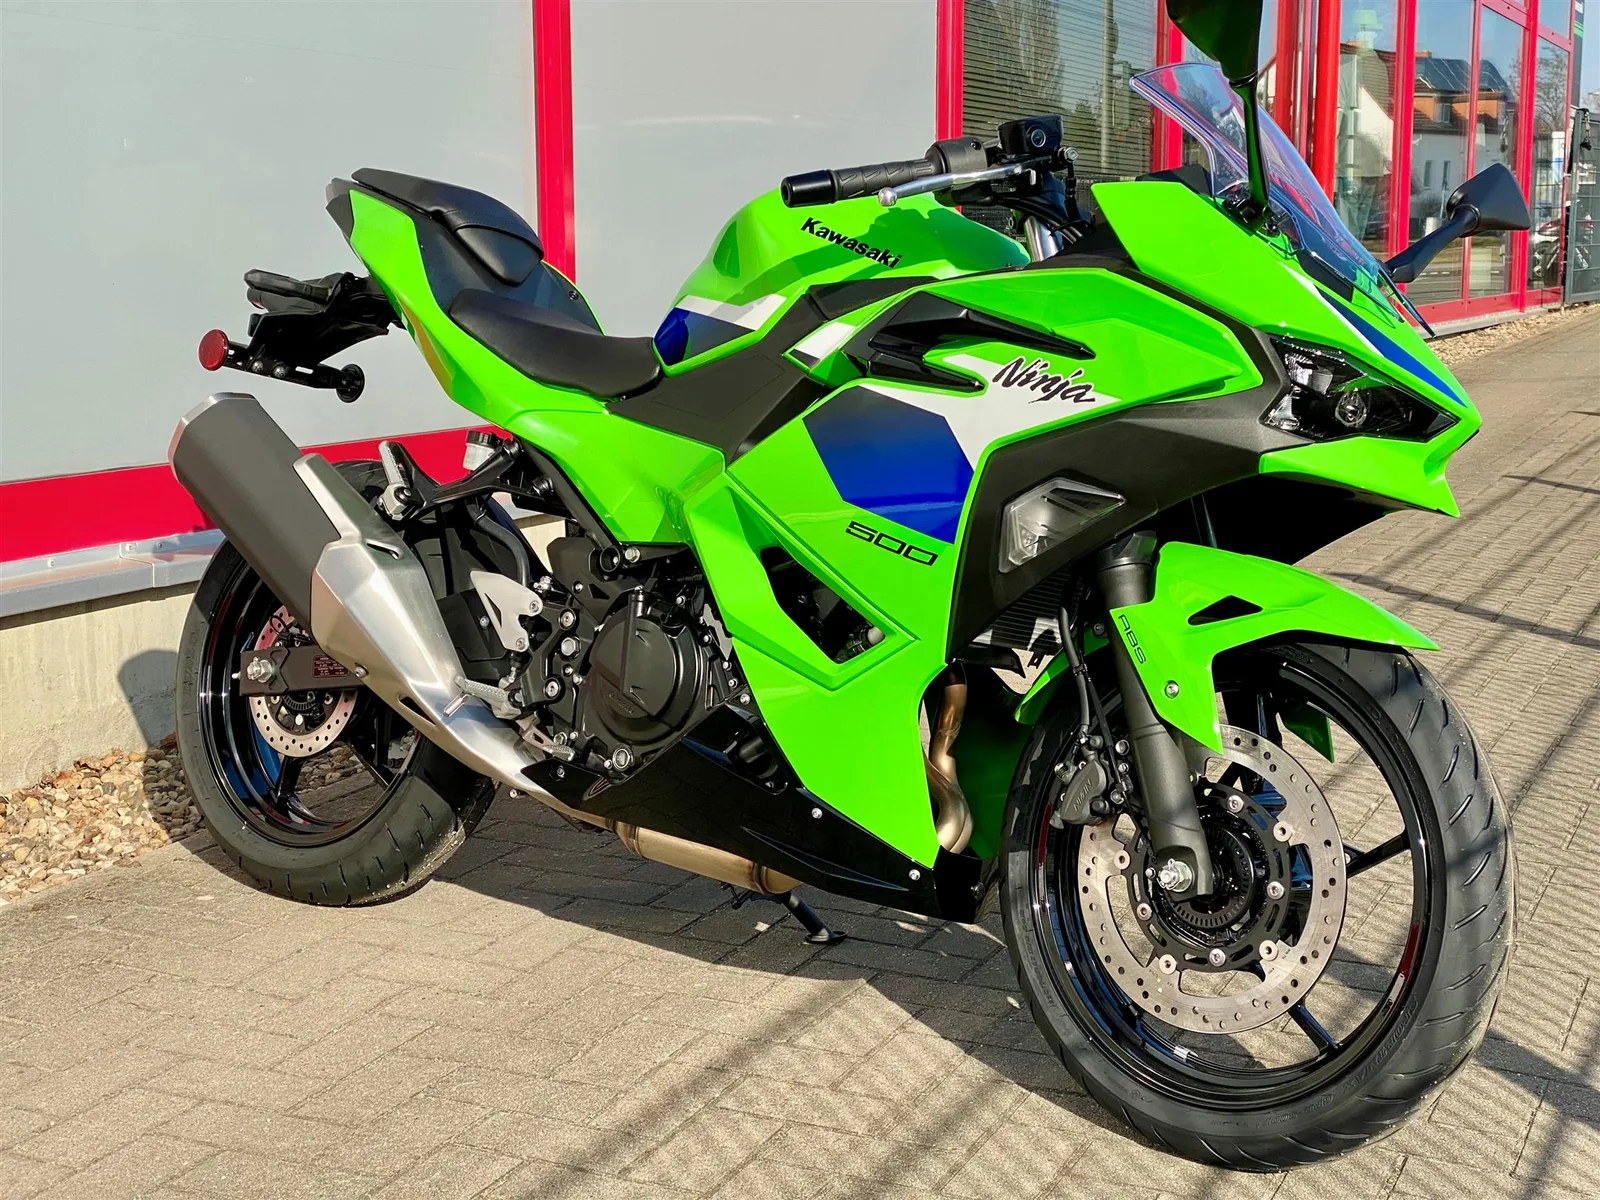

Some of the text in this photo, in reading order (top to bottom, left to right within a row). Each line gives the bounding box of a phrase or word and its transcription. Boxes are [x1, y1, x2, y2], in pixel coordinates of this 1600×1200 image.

[801, 217, 902, 268] Kawasaki
[992, 357, 1095, 404] Ninja
[845, 520, 939, 567] 500
[1118, 614, 1147, 664] ABS
